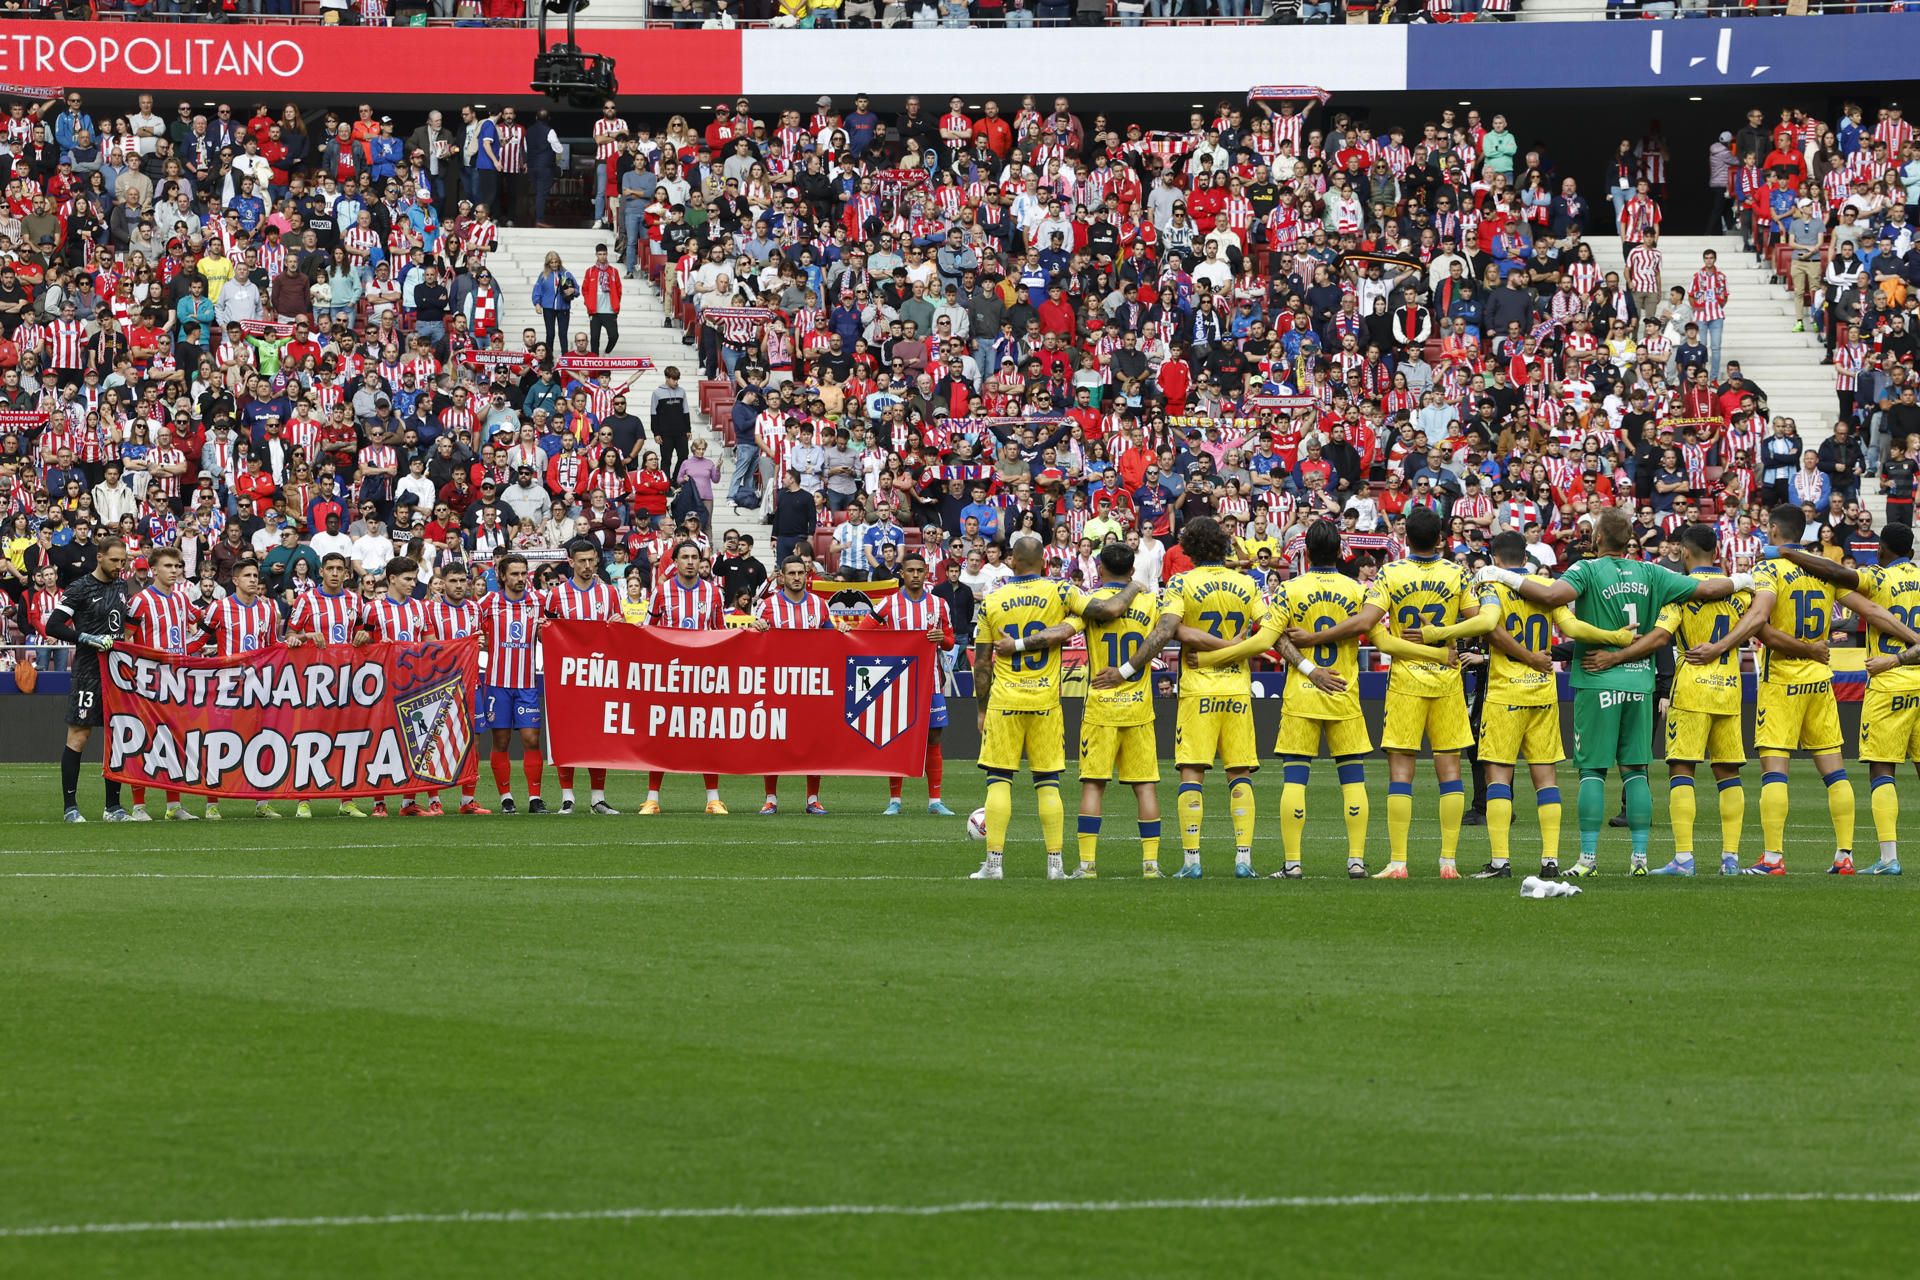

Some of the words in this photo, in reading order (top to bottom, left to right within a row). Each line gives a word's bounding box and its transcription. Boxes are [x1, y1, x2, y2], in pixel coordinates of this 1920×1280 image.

[475, 354, 497, 364] CHOLO
[572, 357, 604, 367] ATLÉTICO
[610, 359, 639, 367] MADRID
[1001, 596, 1048, 612] SANDRO
[1221, 581, 1251, 605] SILVA
[1789, 589, 1826, 640] 15
[1505, 612, 1549, 663] 20
[1708, 614, 1730, 665] 4
[1101, 631, 1145, 683] 10
[109, 650, 385, 709] CENTENARIO
[560, 652, 619, 689] PEÑA
[626, 658, 730, 695] ATLÉTICA
[740, 665, 767, 695] DE
[773, 666, 834, 696] UTIEL
[1786, 680, 1830, 697] Binter
[78, 690, 94, 708] 13
[487, 696, 496, 712] 7
[1199, 697, 1248, 715] Binter
[603, 702, 636, 735] EL
[649, 700, 788, 741] PARADÓN
[109, 714, 408, 791] PAIPORTA
